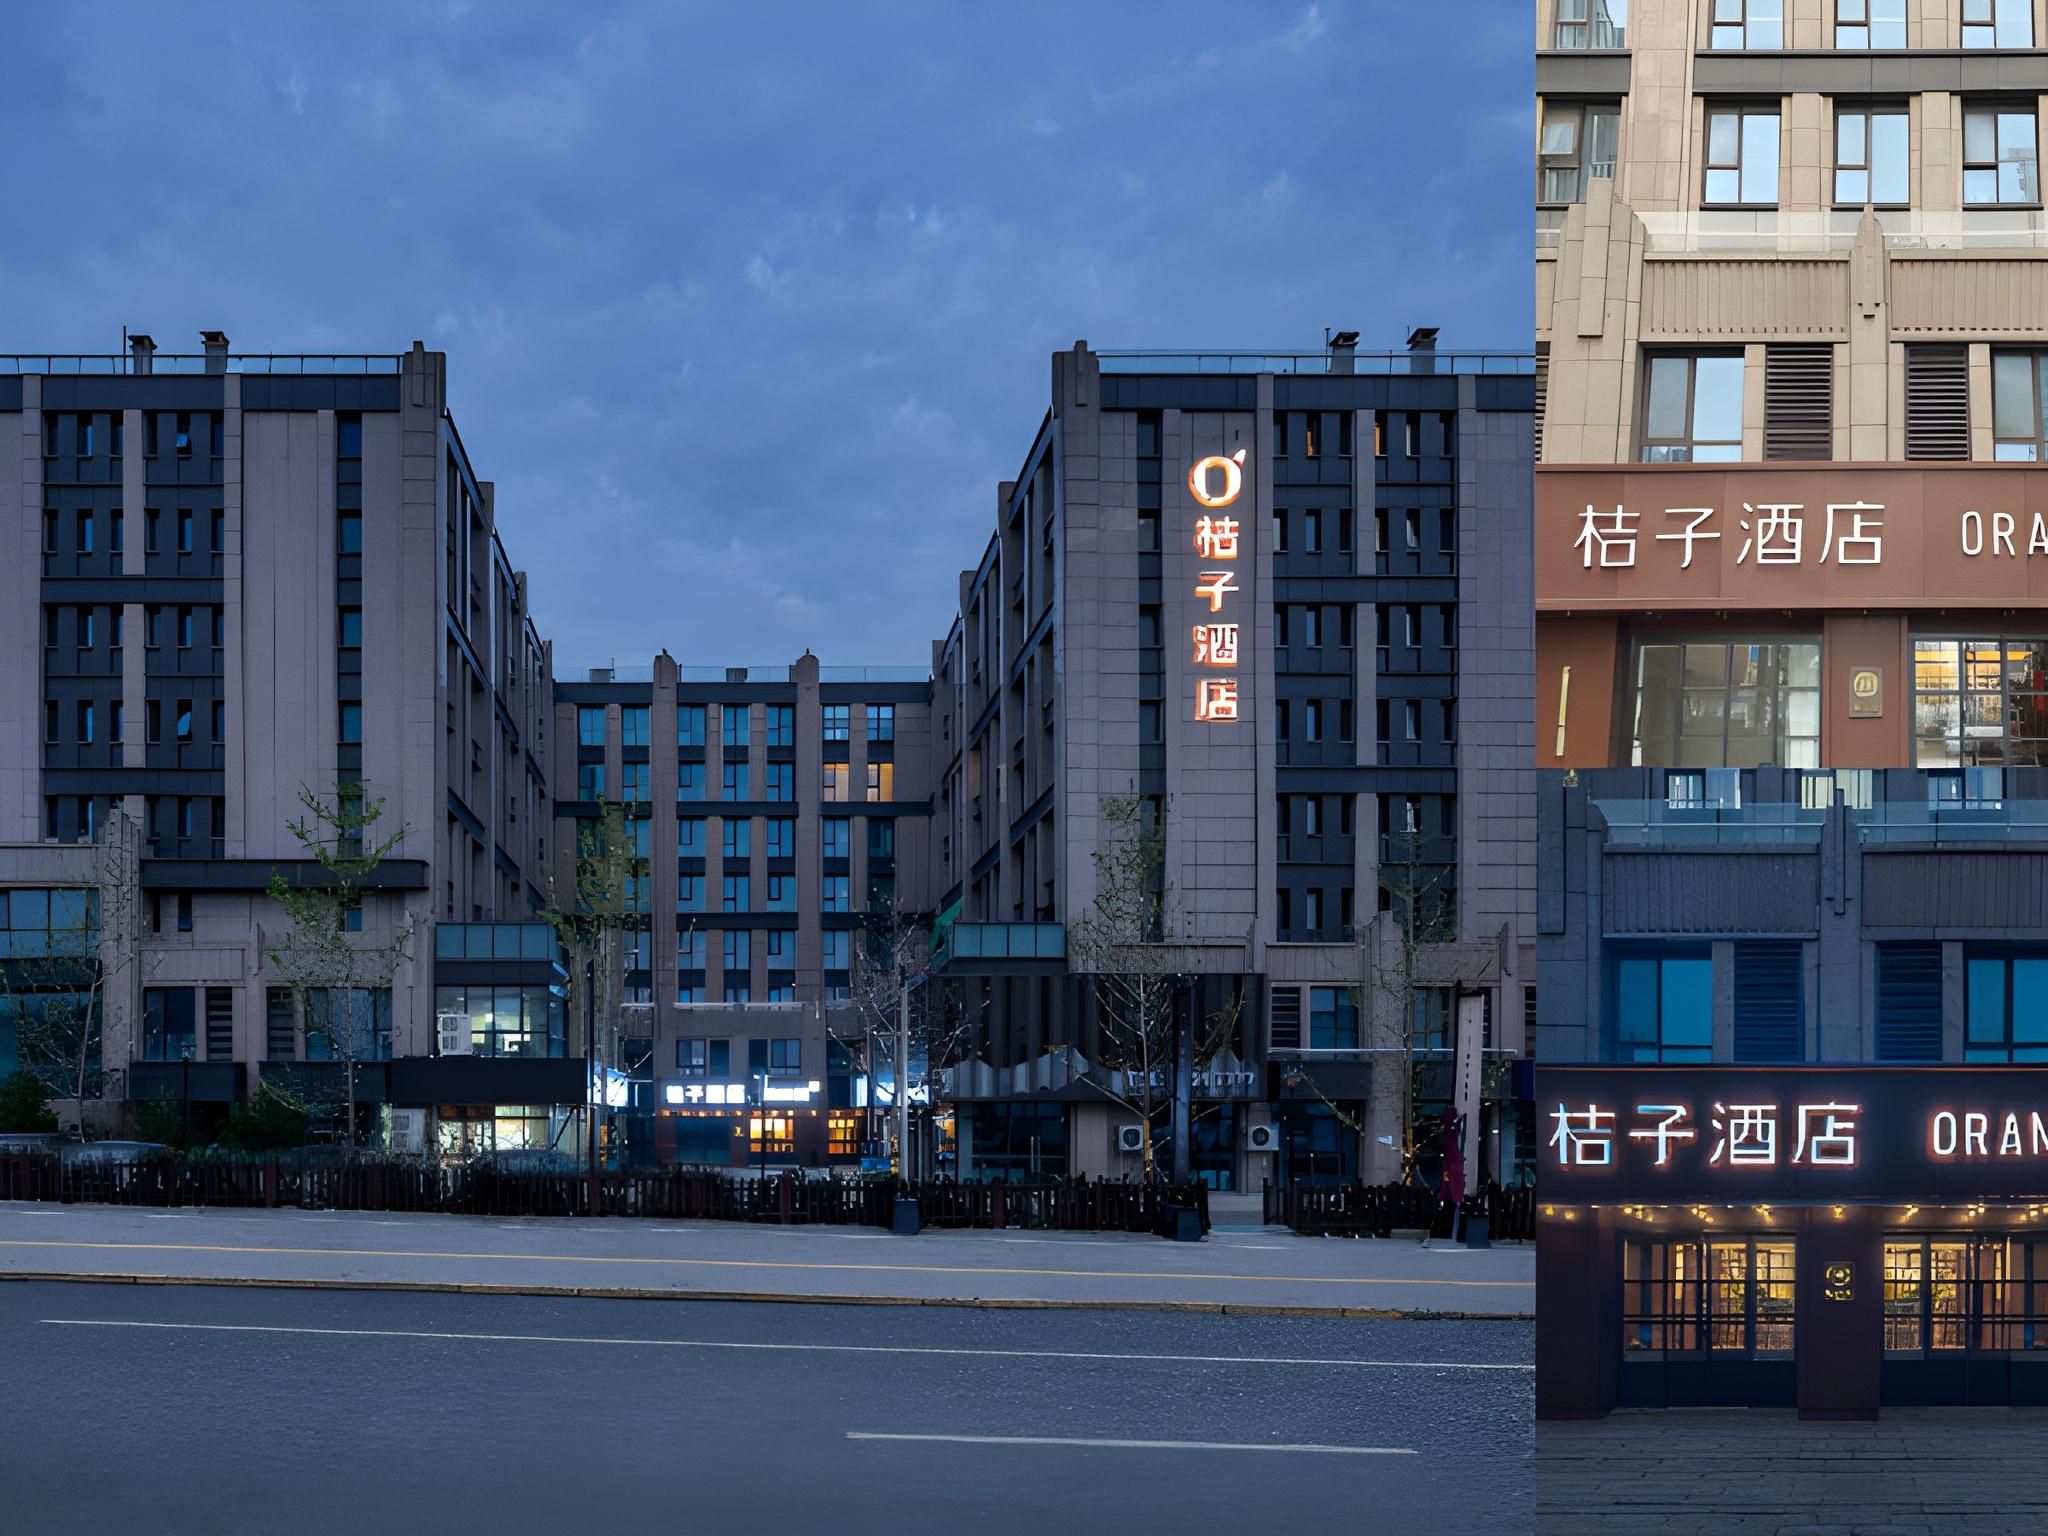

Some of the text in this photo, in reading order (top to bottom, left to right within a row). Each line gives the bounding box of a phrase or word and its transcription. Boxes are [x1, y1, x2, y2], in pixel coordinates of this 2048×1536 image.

[1573, 500, 1886, 568] 桔子酒店
[1961, 510, 2048, 556] ORA
[1194, 515, 1240, 721] 桔子酒店
[1549, 1101, 1860, 1165] 桔子酒店
[1933, 1111, 2048, 1155] ORAN
